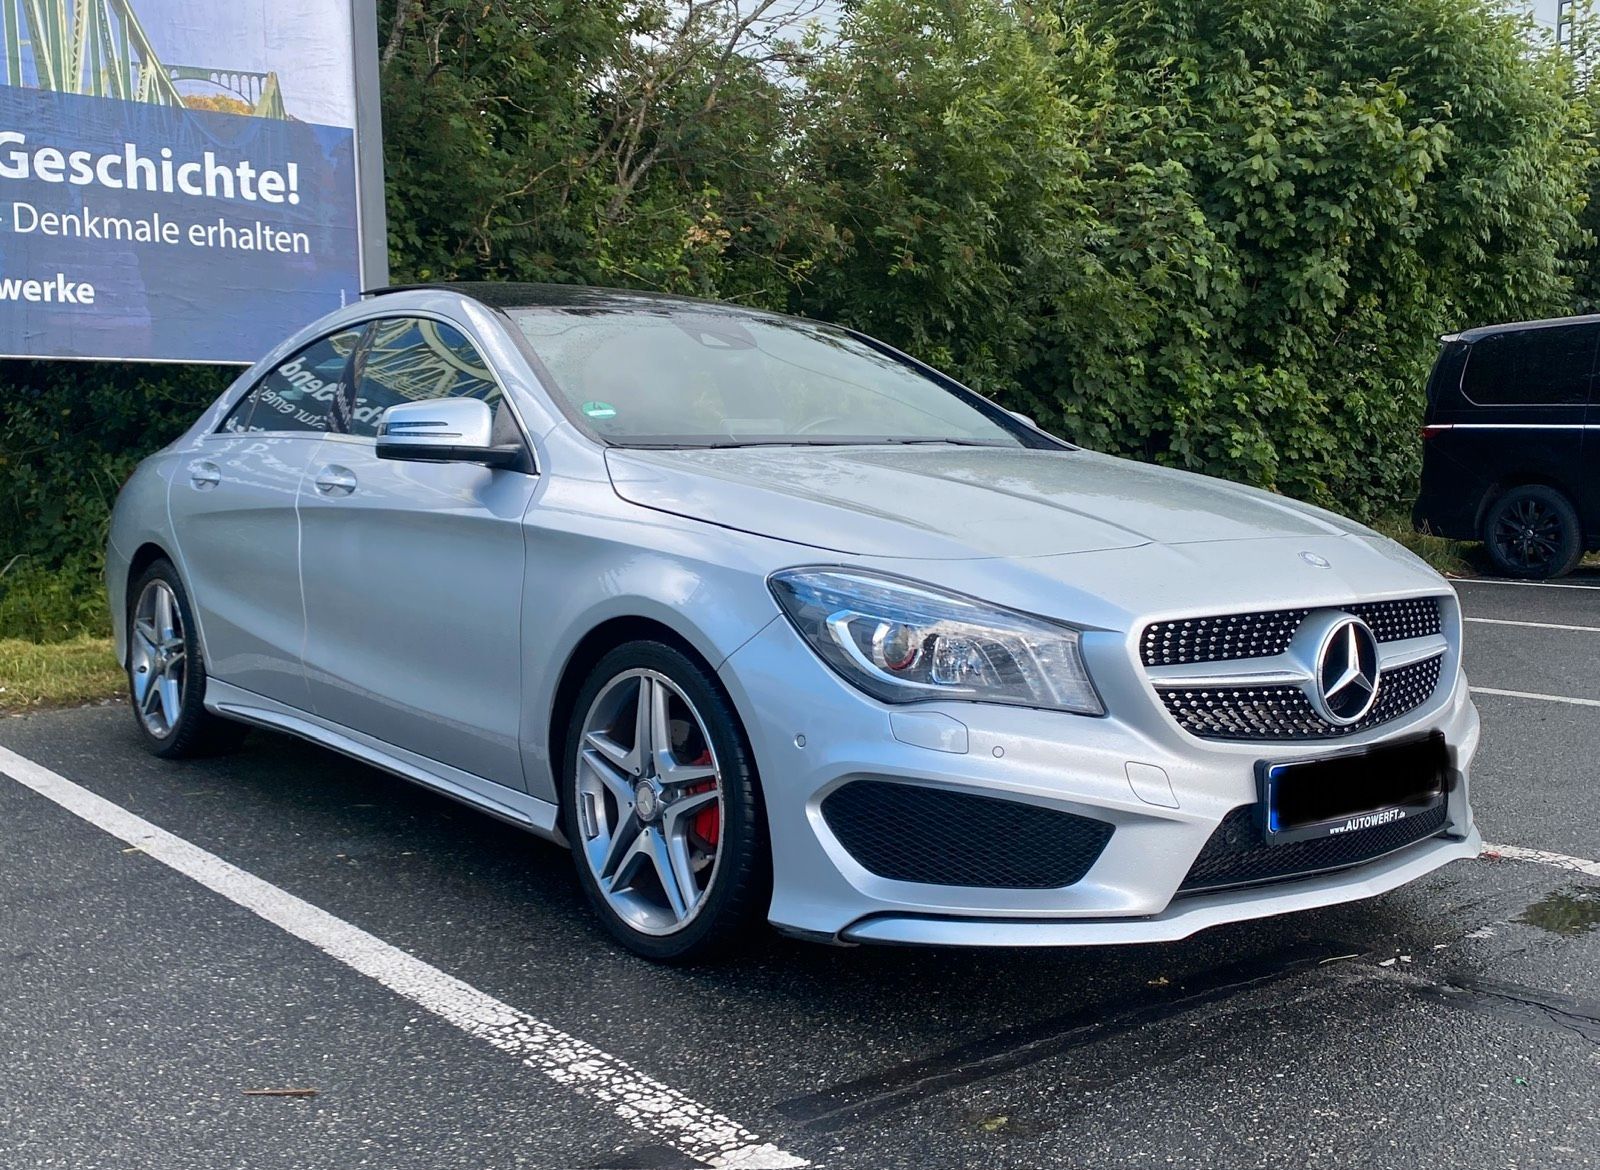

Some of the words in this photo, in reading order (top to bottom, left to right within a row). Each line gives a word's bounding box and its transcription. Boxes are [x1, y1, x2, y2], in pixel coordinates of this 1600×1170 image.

[0, 131, 300, 206] Geschichte!
[12, 201, 180, 244] Denkmale
[188, 218, 310, 254] erhalten
[0, 272, 95, 304] werke
[1329, 808, 1406, 835] www.AUTOWERFT.de
